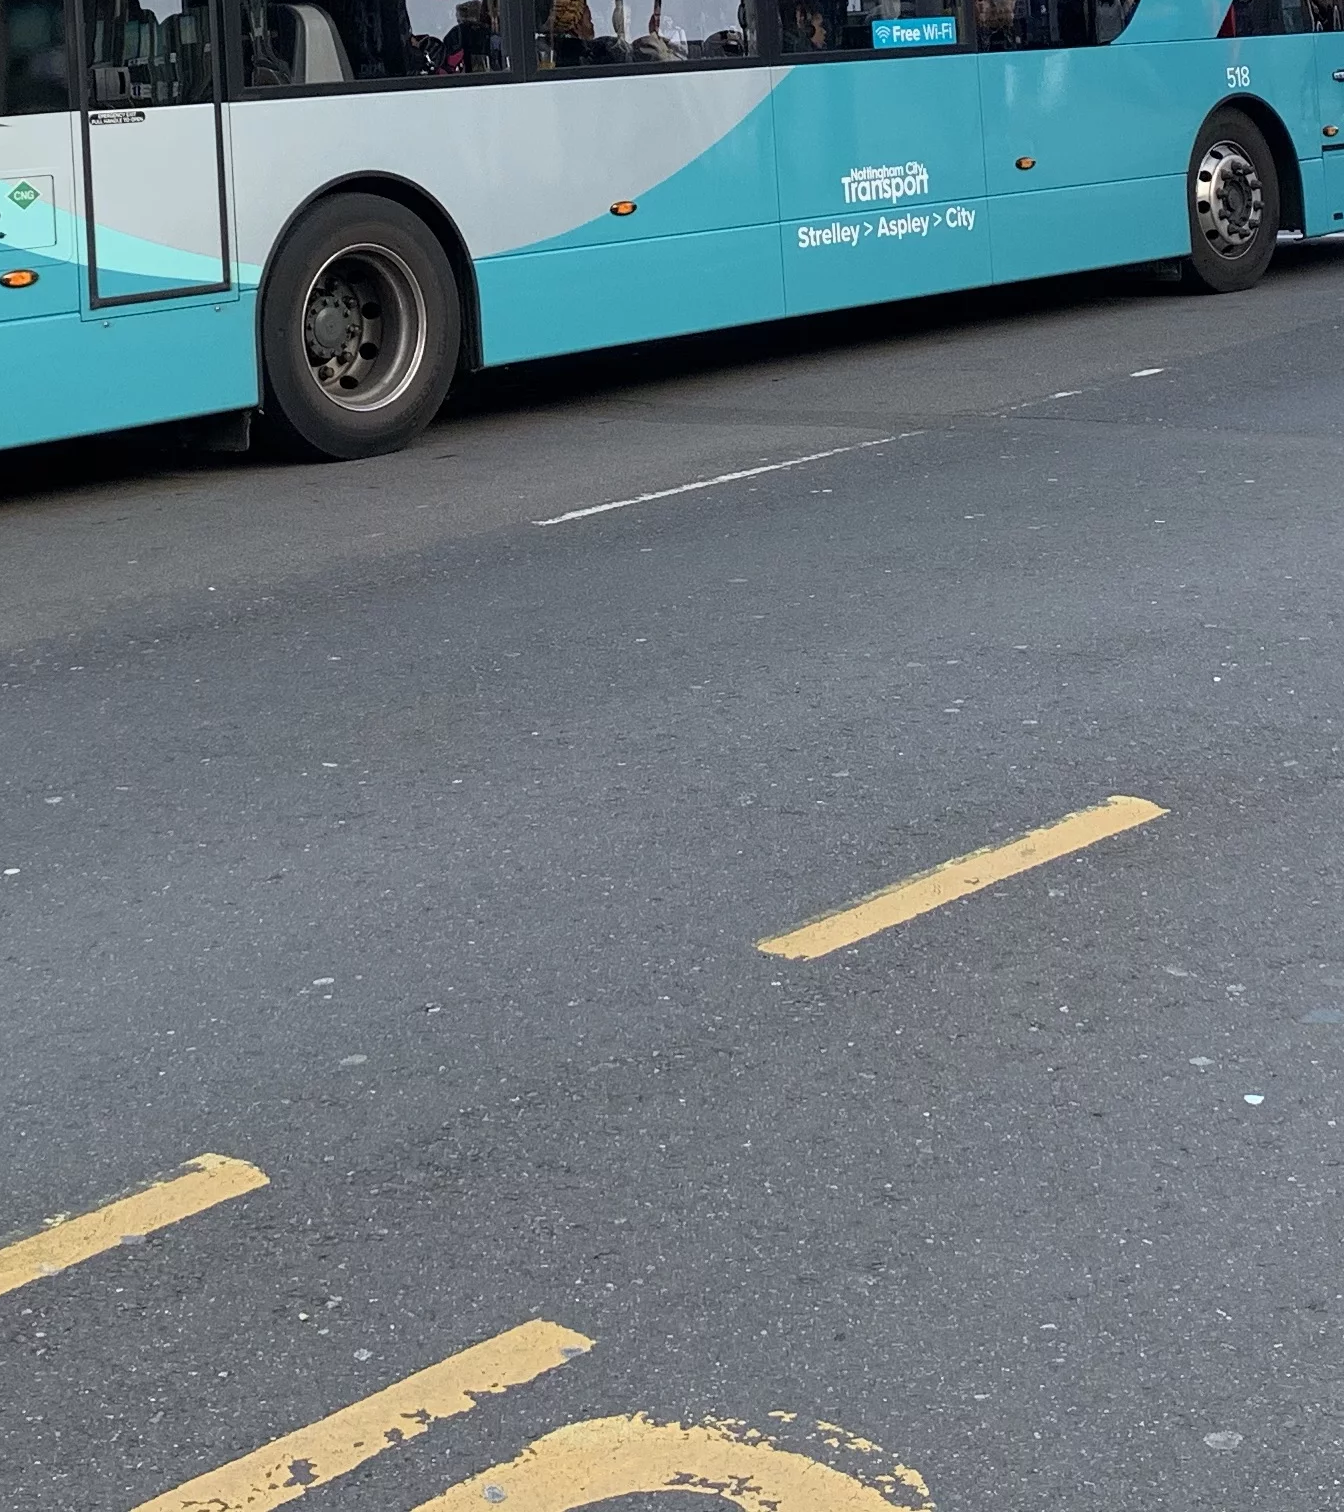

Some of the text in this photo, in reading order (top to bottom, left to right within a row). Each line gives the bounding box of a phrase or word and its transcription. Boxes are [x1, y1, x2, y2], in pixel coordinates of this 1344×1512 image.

[892, 22, 953, 43] Free Wi-Fi
[1226, 65, 1250, 88] 518
[850, 161, 925, 182] Nottingham City
[13, 189, 35, 201] CNG
[841, 167, 930, 204] Transport
[798, 222, 860, 248] Strelley
[877, 213, 930, 239] Aspley
[945, 205, 976, 231] City
